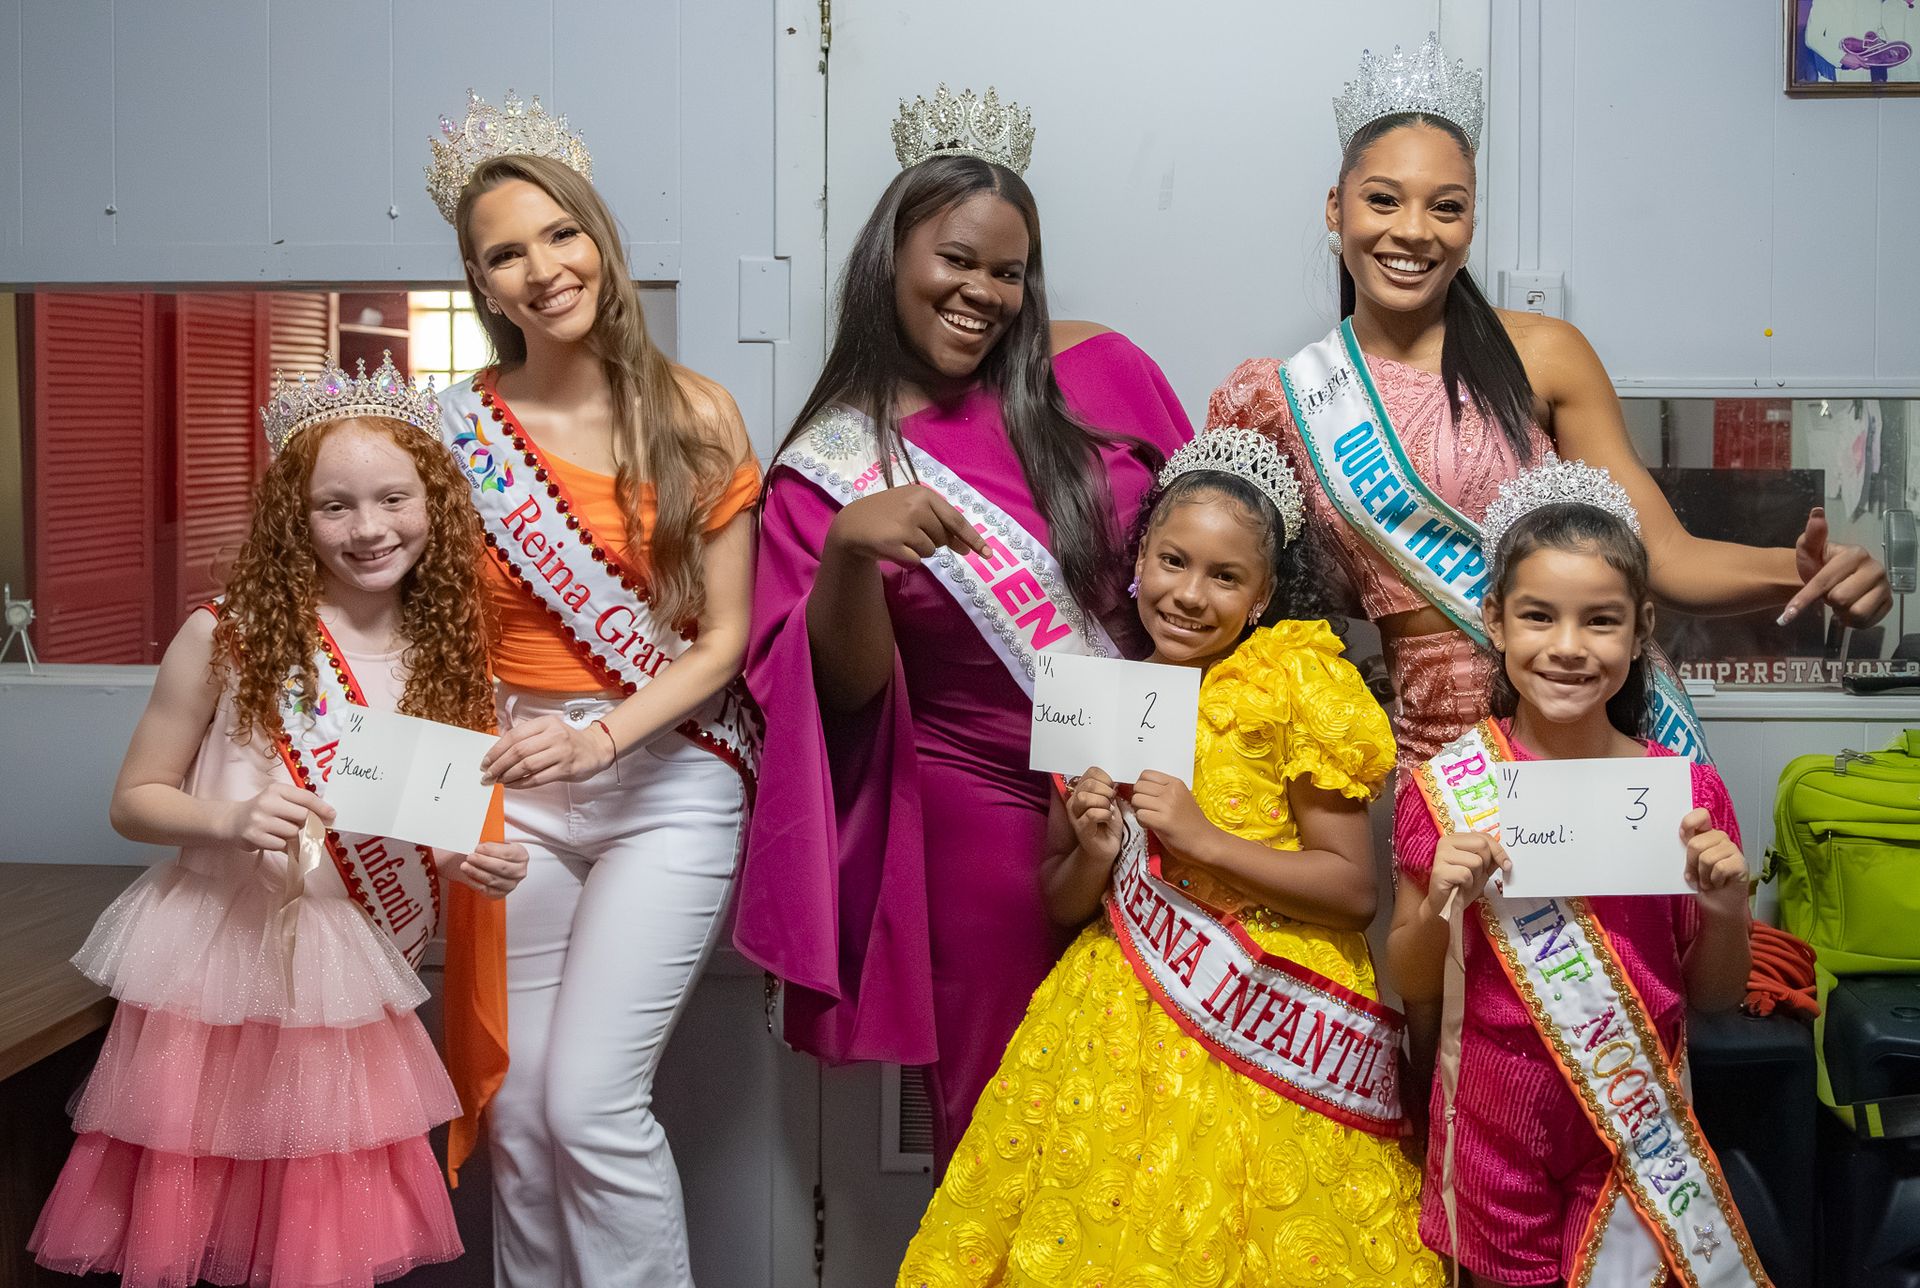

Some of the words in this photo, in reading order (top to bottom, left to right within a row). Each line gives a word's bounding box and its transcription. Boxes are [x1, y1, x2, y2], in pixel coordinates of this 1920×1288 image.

[466, 469, 481, 489] Group
[1334, 421, 1419, 534] QUEEN
[500, 494, 591, 613] Reina
[1679, 661, 1892, 683] SUPERSTATION
[1034, 703, 1092, 727] Kavel:
[1140, 691, 1157, 730] 2
[336, 756, 383, 781] Kavel:
[439, 761, 452, 791] 1
[1506, 824, 1574, 848] Kavel:
[1625, 787, 1650, 821] 3
[353, 836, 423, 935] Infantil
[1119, 848, 1211, 988] REINA
[1200, 962, 1382, 1098] INFANTIL
